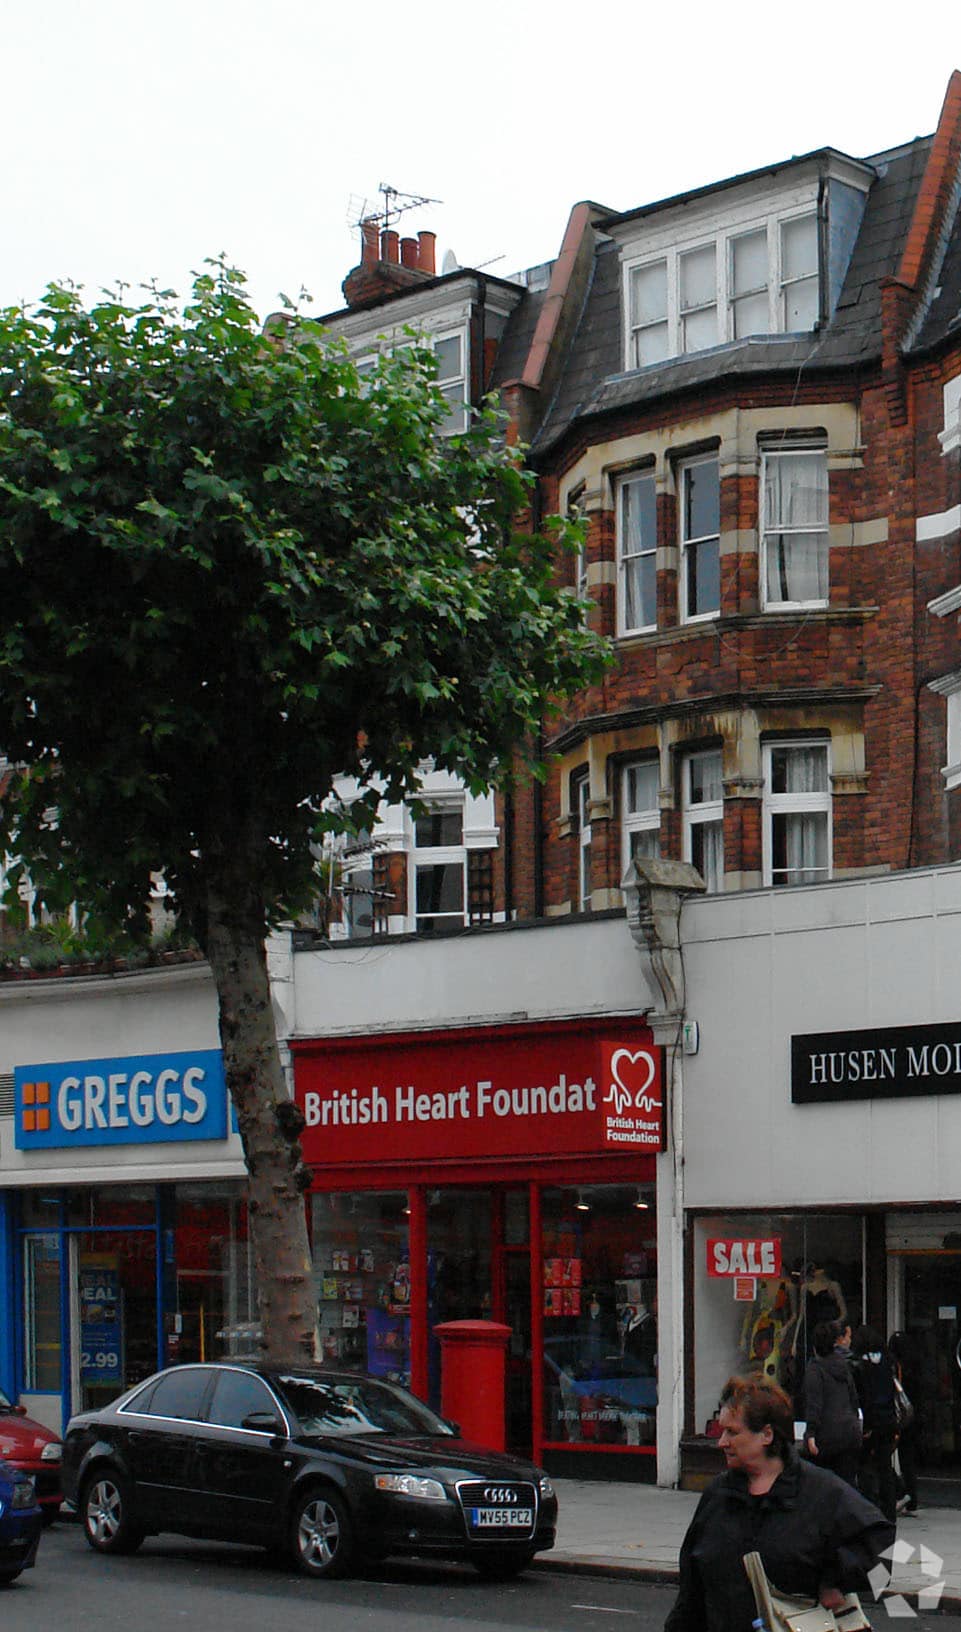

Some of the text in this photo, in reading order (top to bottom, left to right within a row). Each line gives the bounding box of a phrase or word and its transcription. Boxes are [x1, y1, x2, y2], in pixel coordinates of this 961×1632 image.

[809, 1048, 897, 1084] HUSEN
[58, 1067, 207, 1131] GREGGS
[304, 1074, 596, 1127] British Heart Foundat
[607, 1117, 660, 1131] British Heart
[607, 1130, 660, 1144] Foundation
[713, 1242, 776, 1274] SALE
[81, 1287, 118, 1301] EAL
